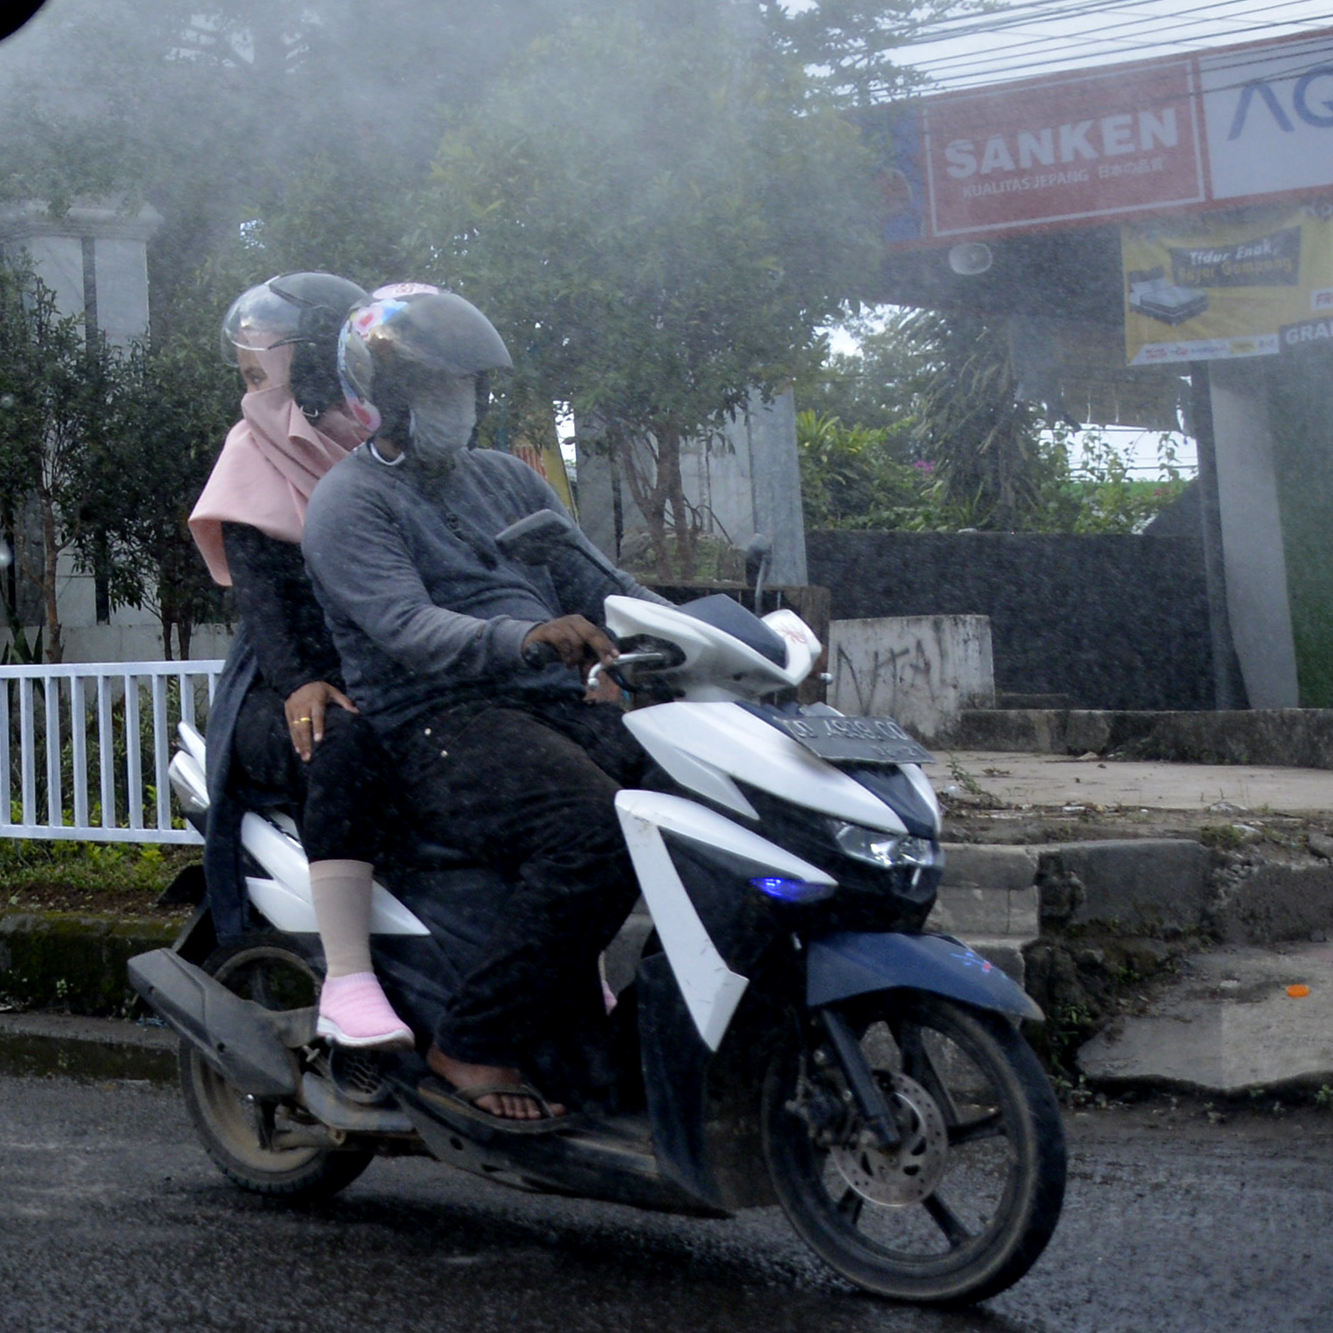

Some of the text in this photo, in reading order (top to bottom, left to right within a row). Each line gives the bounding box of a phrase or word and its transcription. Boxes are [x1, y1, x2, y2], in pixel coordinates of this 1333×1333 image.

[944, 107, 1179, 179] SANKEN
[963, 169, 1089, 198] KUALITAS JEPANG
[1188, 250, 1231, 266] Tidur
